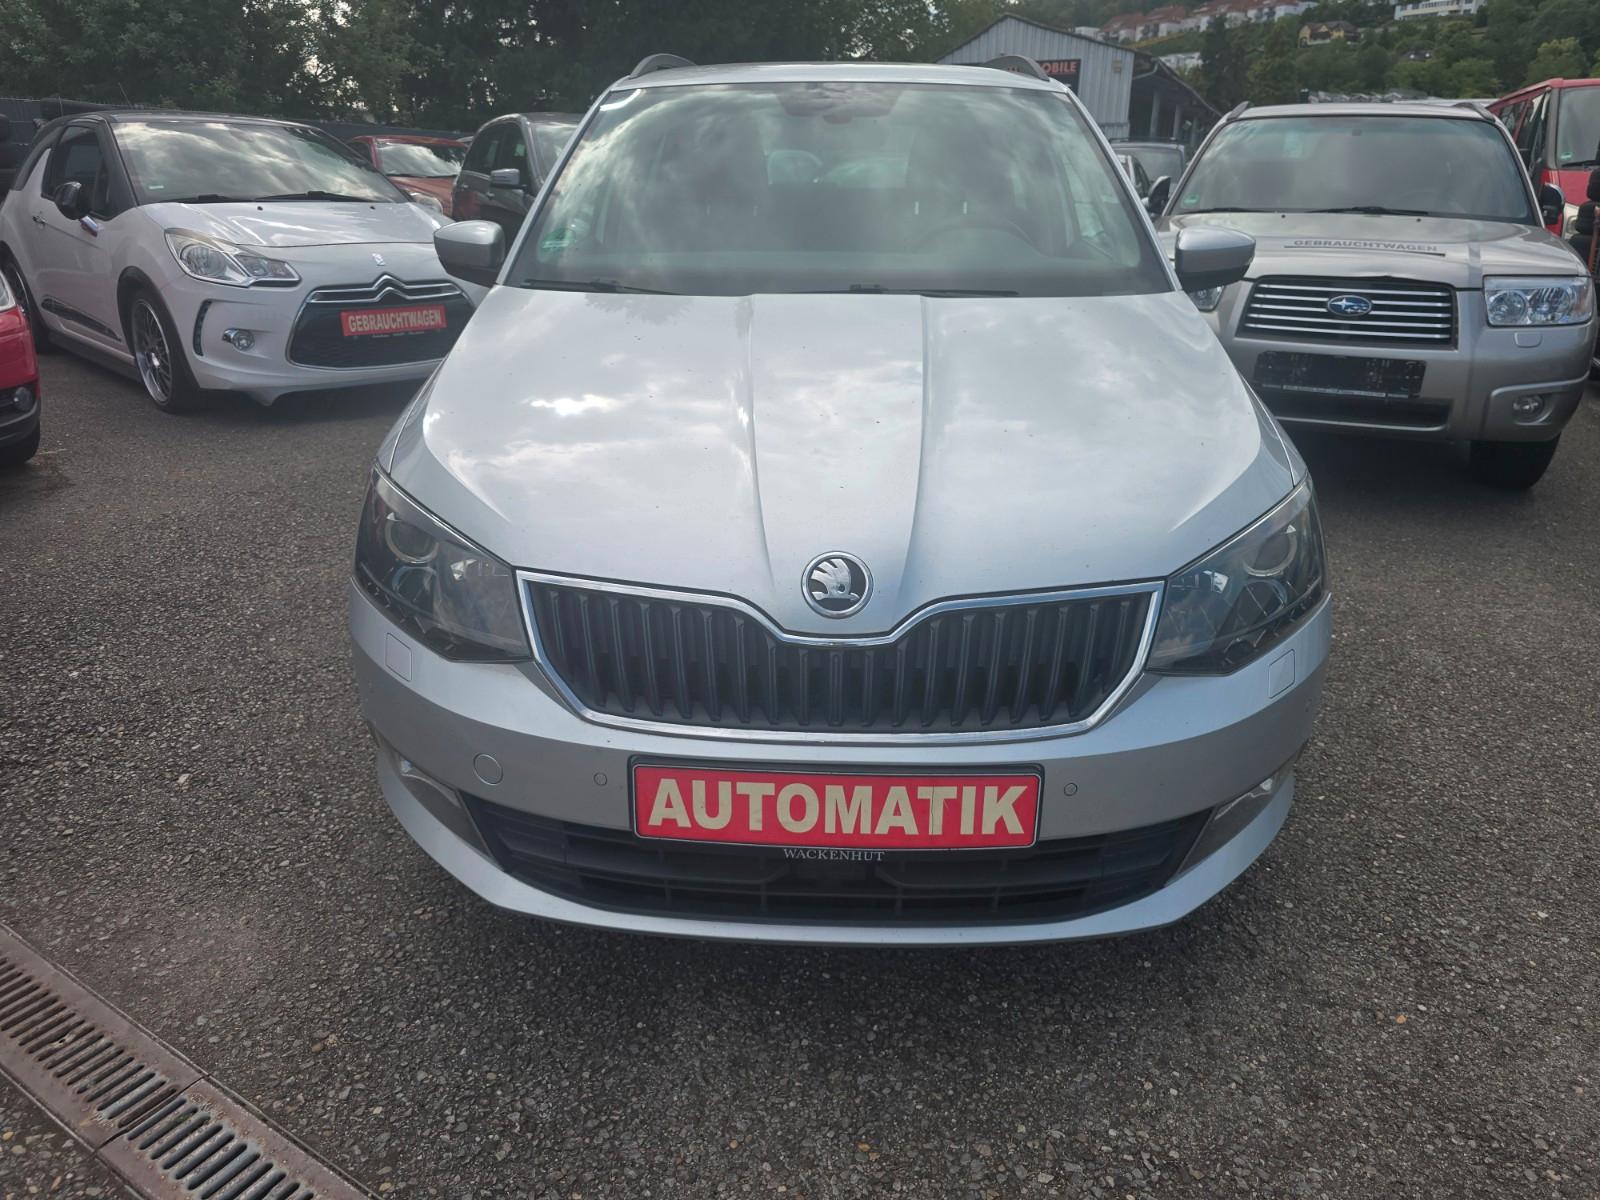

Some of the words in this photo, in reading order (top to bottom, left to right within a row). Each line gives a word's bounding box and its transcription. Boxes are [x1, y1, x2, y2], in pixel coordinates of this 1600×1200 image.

[1040, 61, 1077, 73] OBILE
[1294, 240, 1437, 251] GEBRAUCHTWAGEN
[348, 310, 441, 332] GEBRAUCHTWAGEN
[648, 778, 1028, 835] AUTOMATIK
[783, 847, 885, 862] WACKENHUT
